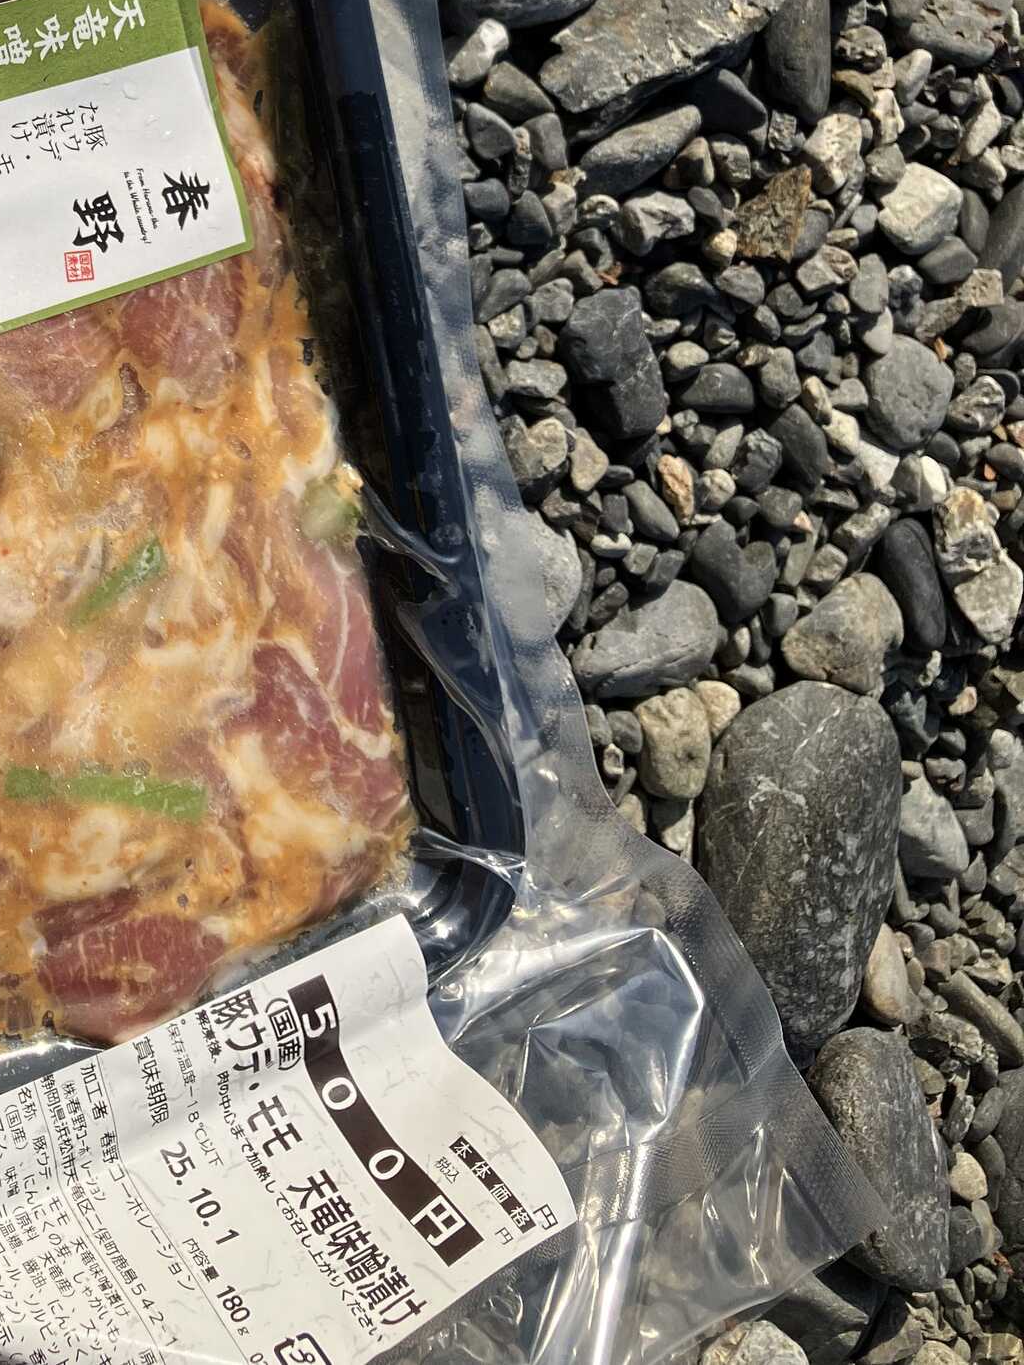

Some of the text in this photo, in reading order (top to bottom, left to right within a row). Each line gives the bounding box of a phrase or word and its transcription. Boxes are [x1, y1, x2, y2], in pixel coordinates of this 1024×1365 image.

[11, 101, 100, 142] たれ漬け
[265, 997, 302, 1071] (国産)
[17, 1087, 38, 1122] 名称
[80, 1062, 110, 1120] 加工者
[132, 1036, 171, 1128] 賞味期限
[301, 1002, 466, 1249] 500円
[431, 1154, 515, 1247] 税込 円
[454, 1138, 532, 1231] 本体価格
[533, 1202, 560, 1232] 円
[182, 1237, 221, 1284] 内容量
[287, 1167, 428, 1325] 天竜味噌漬け
